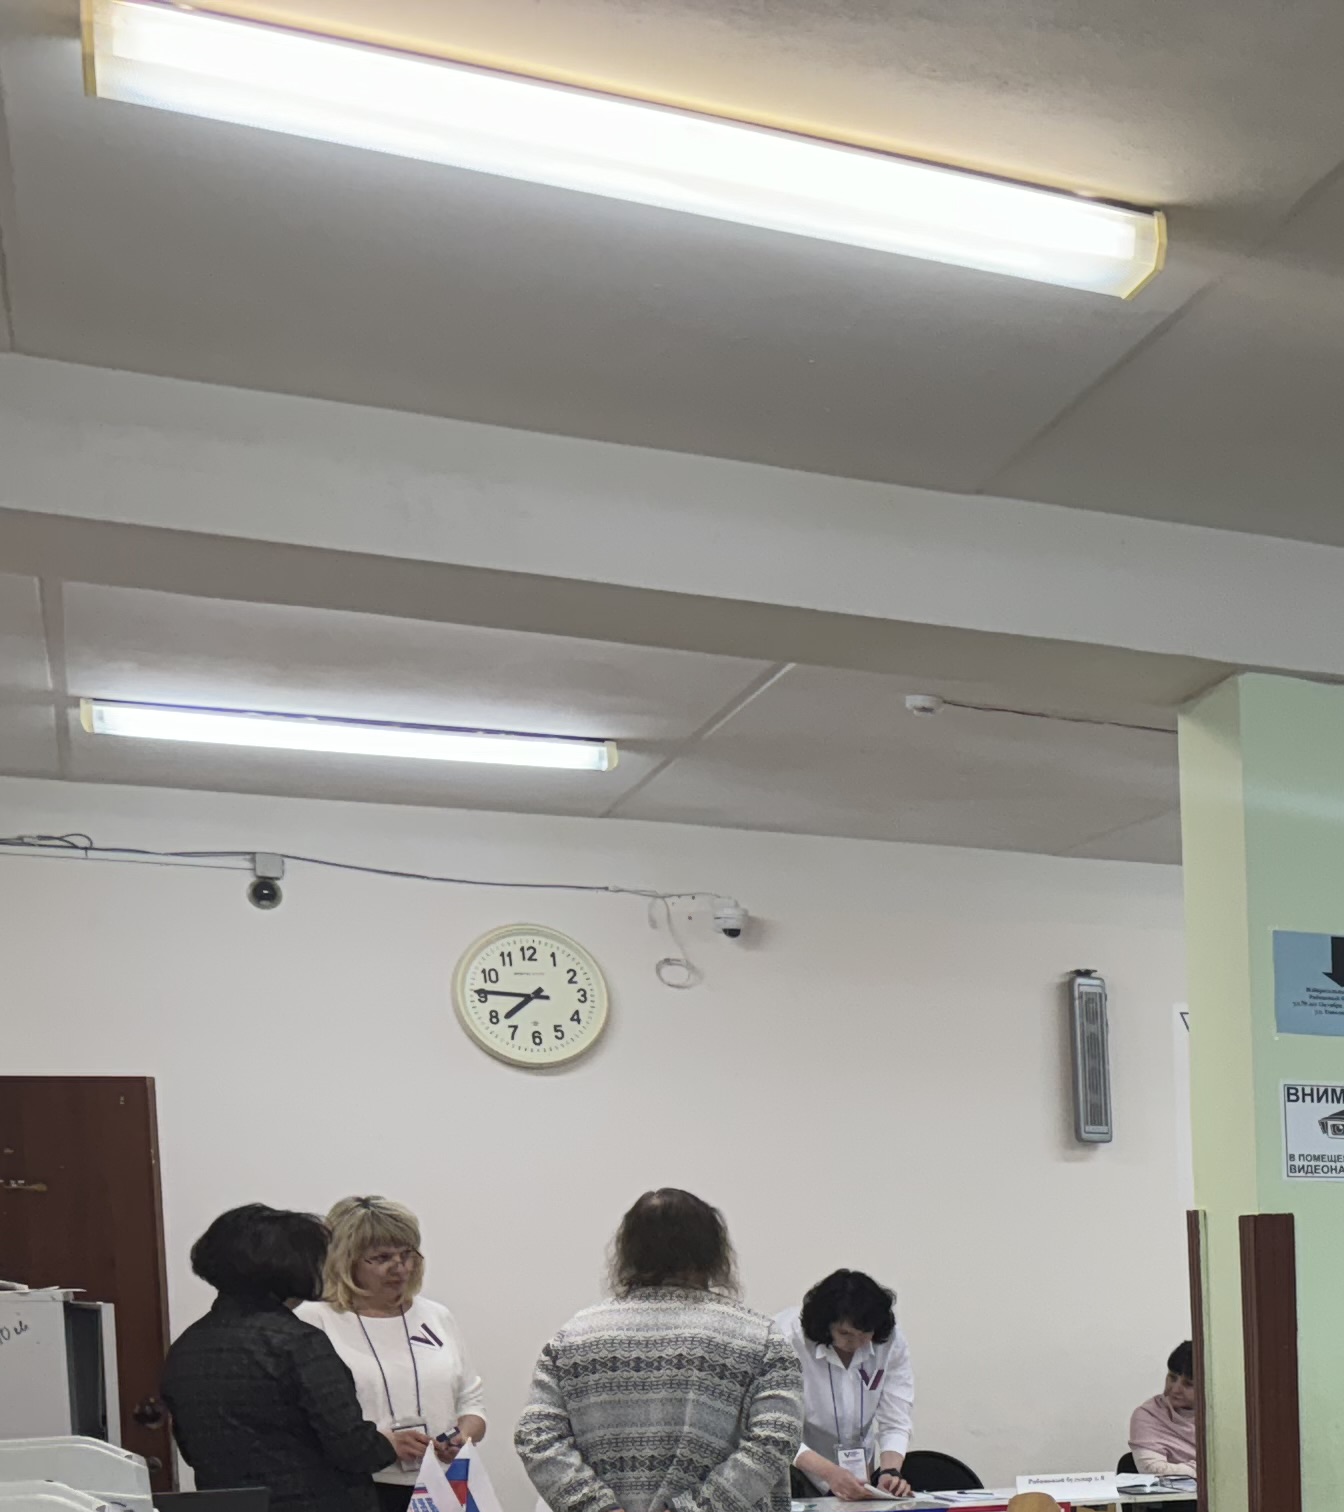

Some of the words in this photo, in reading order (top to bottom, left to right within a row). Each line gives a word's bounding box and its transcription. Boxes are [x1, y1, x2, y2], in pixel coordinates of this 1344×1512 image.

[500, 951, 512, 967] 11
[520, 946, 537, 961] 12
[550, 952, 557, 967] 1
[481, 968, 499, 984] 10
[566, 969, 578, 984] 2
[576, 988, 587, 1003] 3
[489, 1010, 499, 1025] 8
[570, 1010, 581, 1024] 4
[508, 1025, 518, 1040] 7
[532, 1031, 542, 1046] 6
[553, 1025, 565, 1040] 5
[1289, 1154, 1296, 1162] В
